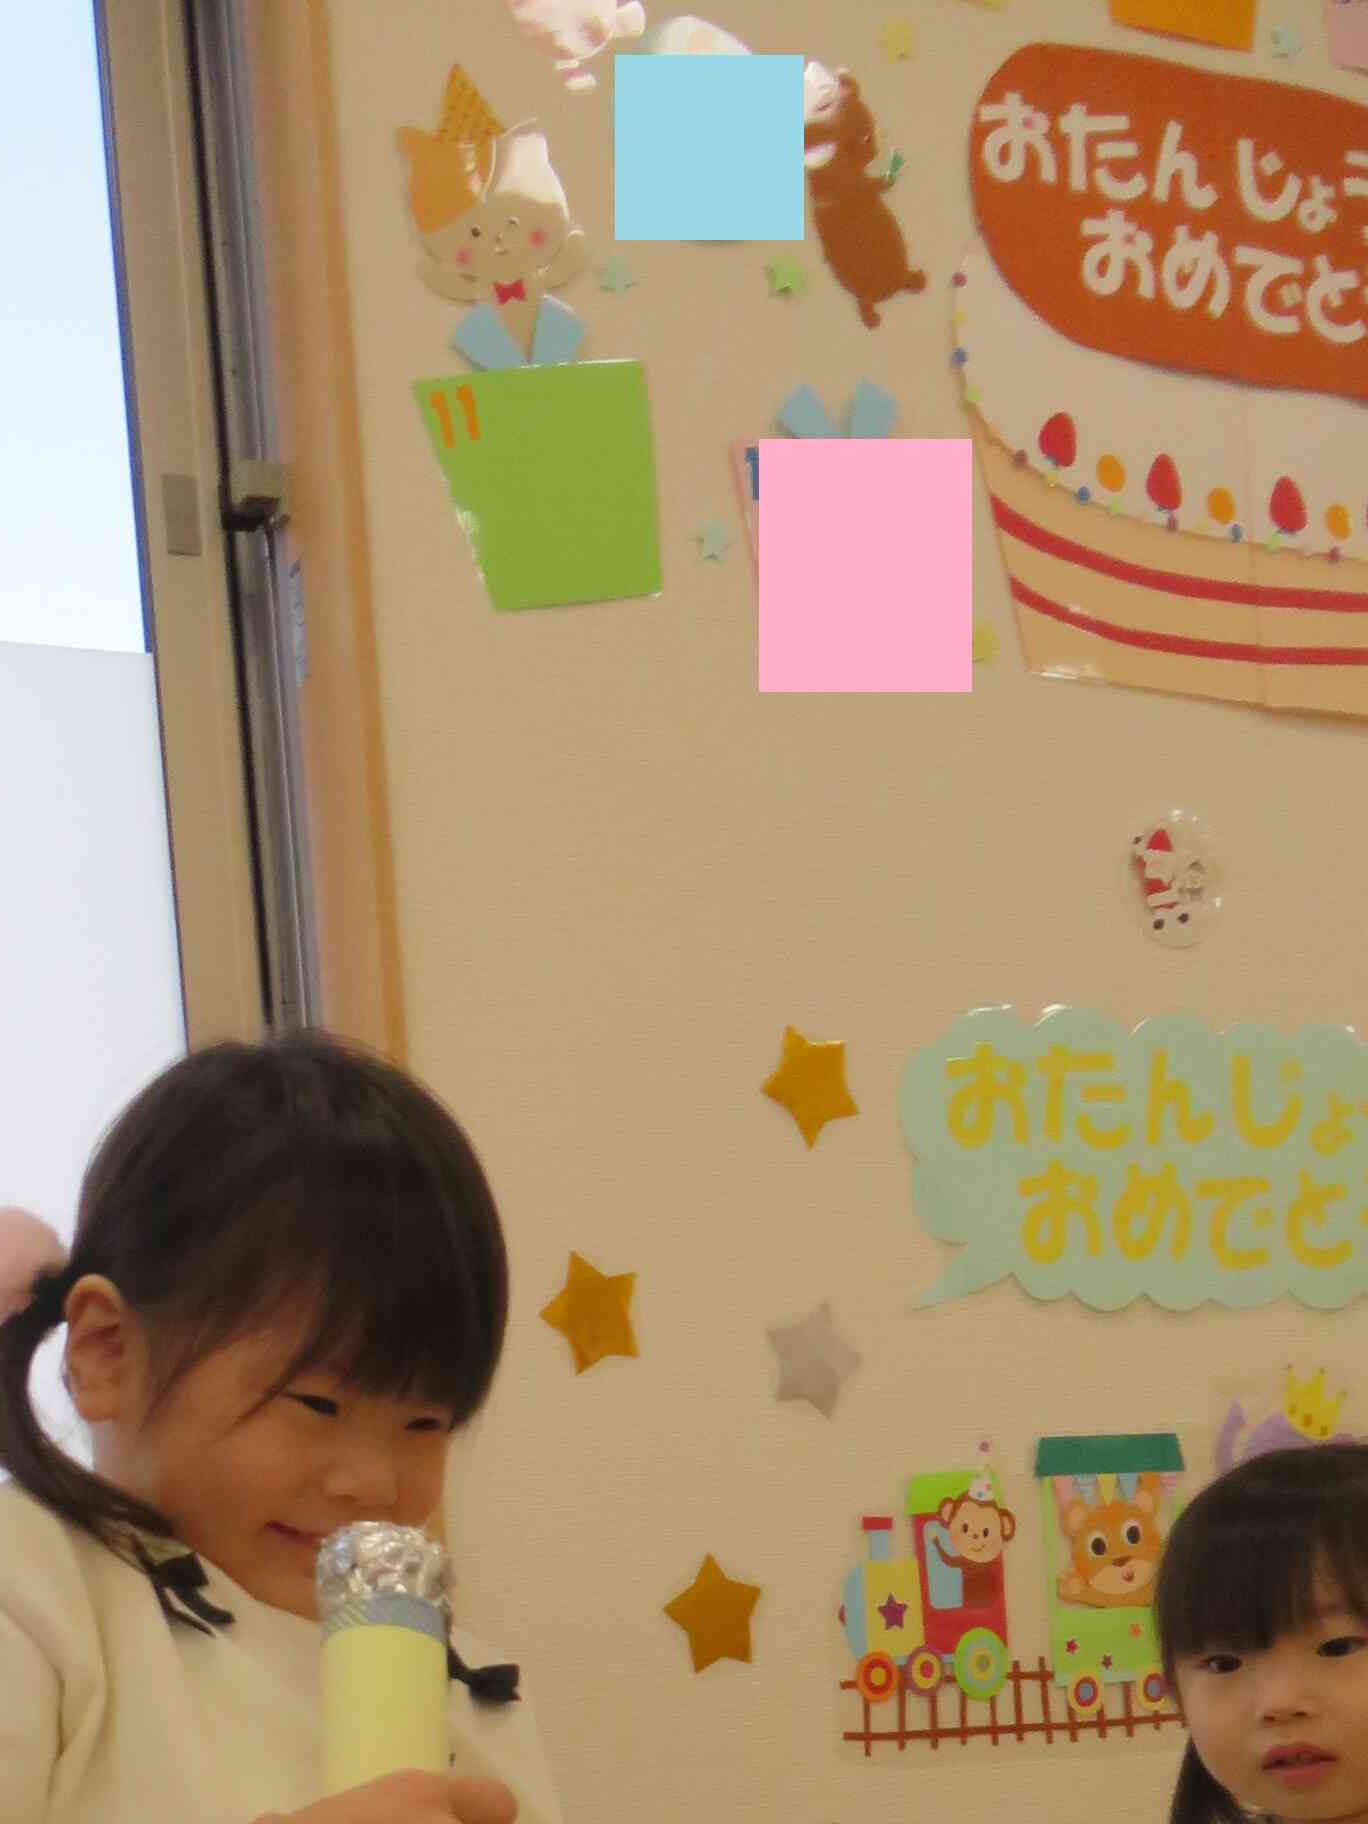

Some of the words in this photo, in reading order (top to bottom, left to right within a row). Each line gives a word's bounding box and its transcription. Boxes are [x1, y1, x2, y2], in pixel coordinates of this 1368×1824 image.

[1080, 209, 1368, 344] おめでと
[945, 1041, 1368, 1158] おたんじょ
[1019, 1159, 1368, 1270] おめでと
